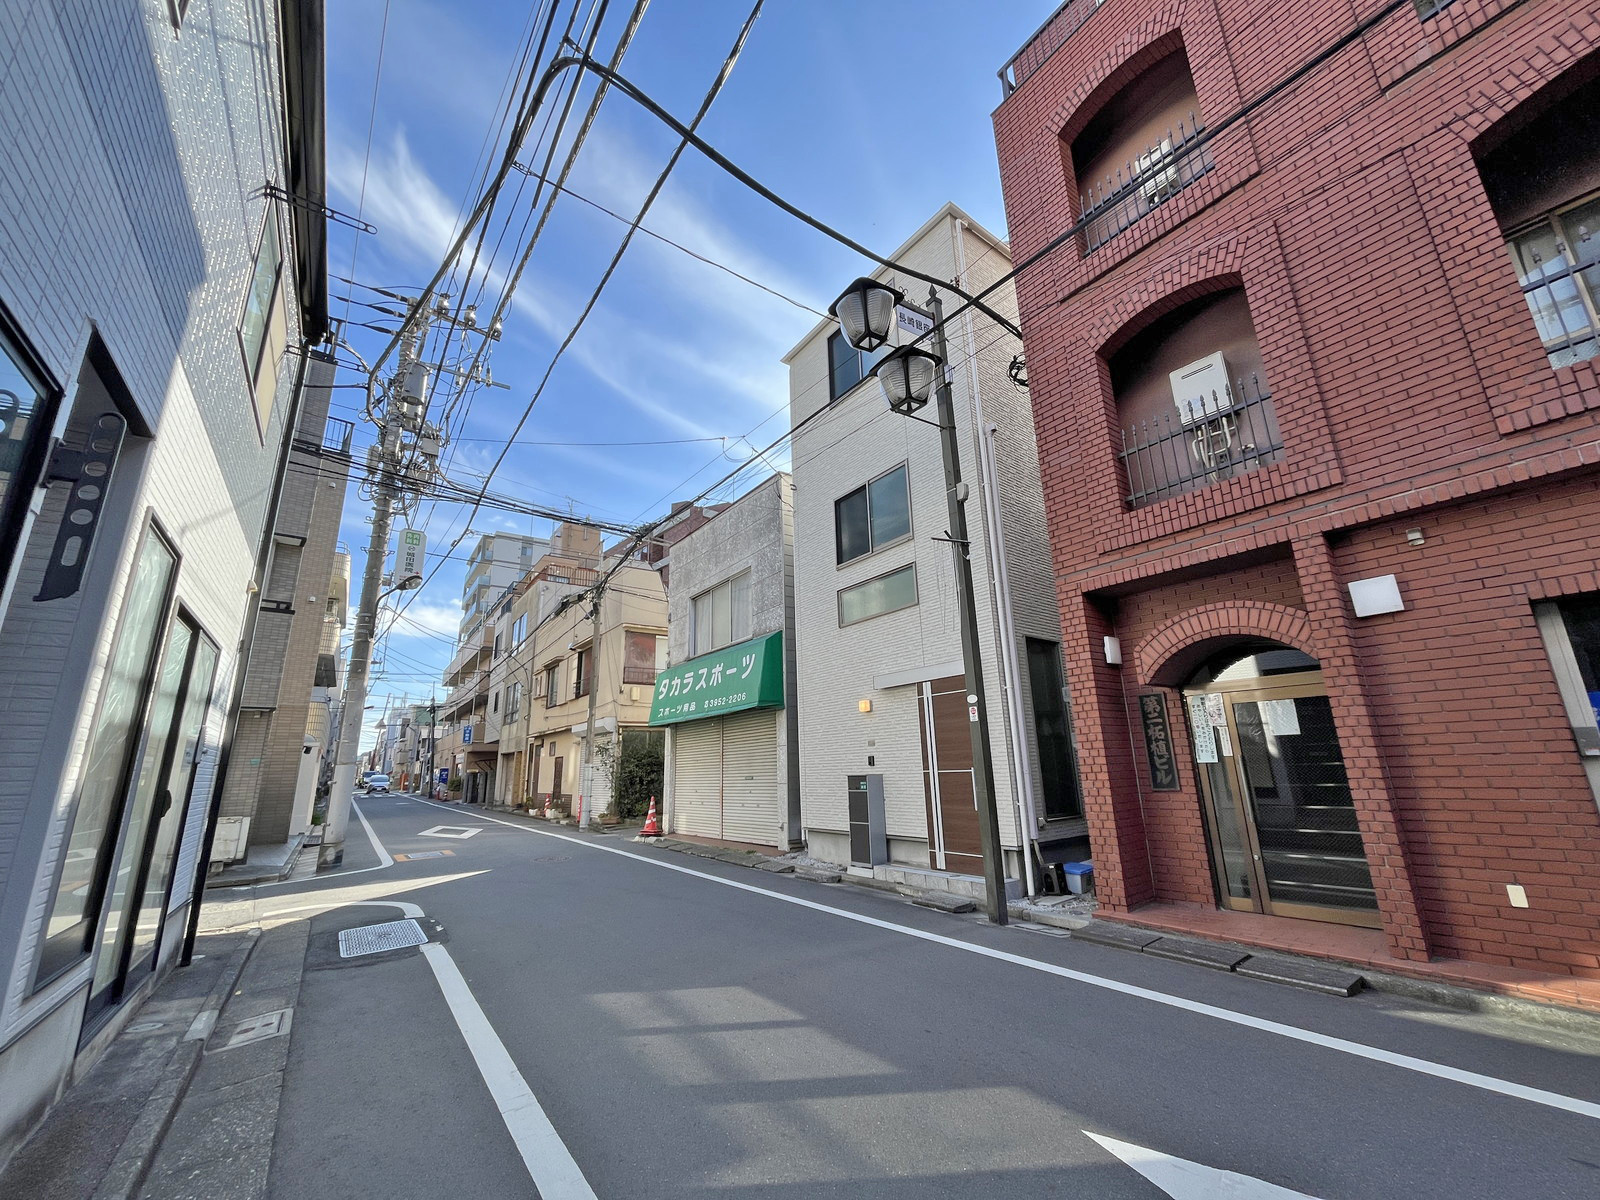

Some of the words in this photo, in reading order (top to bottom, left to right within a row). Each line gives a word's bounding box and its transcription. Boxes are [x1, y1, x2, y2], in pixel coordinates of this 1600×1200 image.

[658, 653, 756, 701] タカラスポーツ
[657, 701, 696, 718] スポーツ用品
